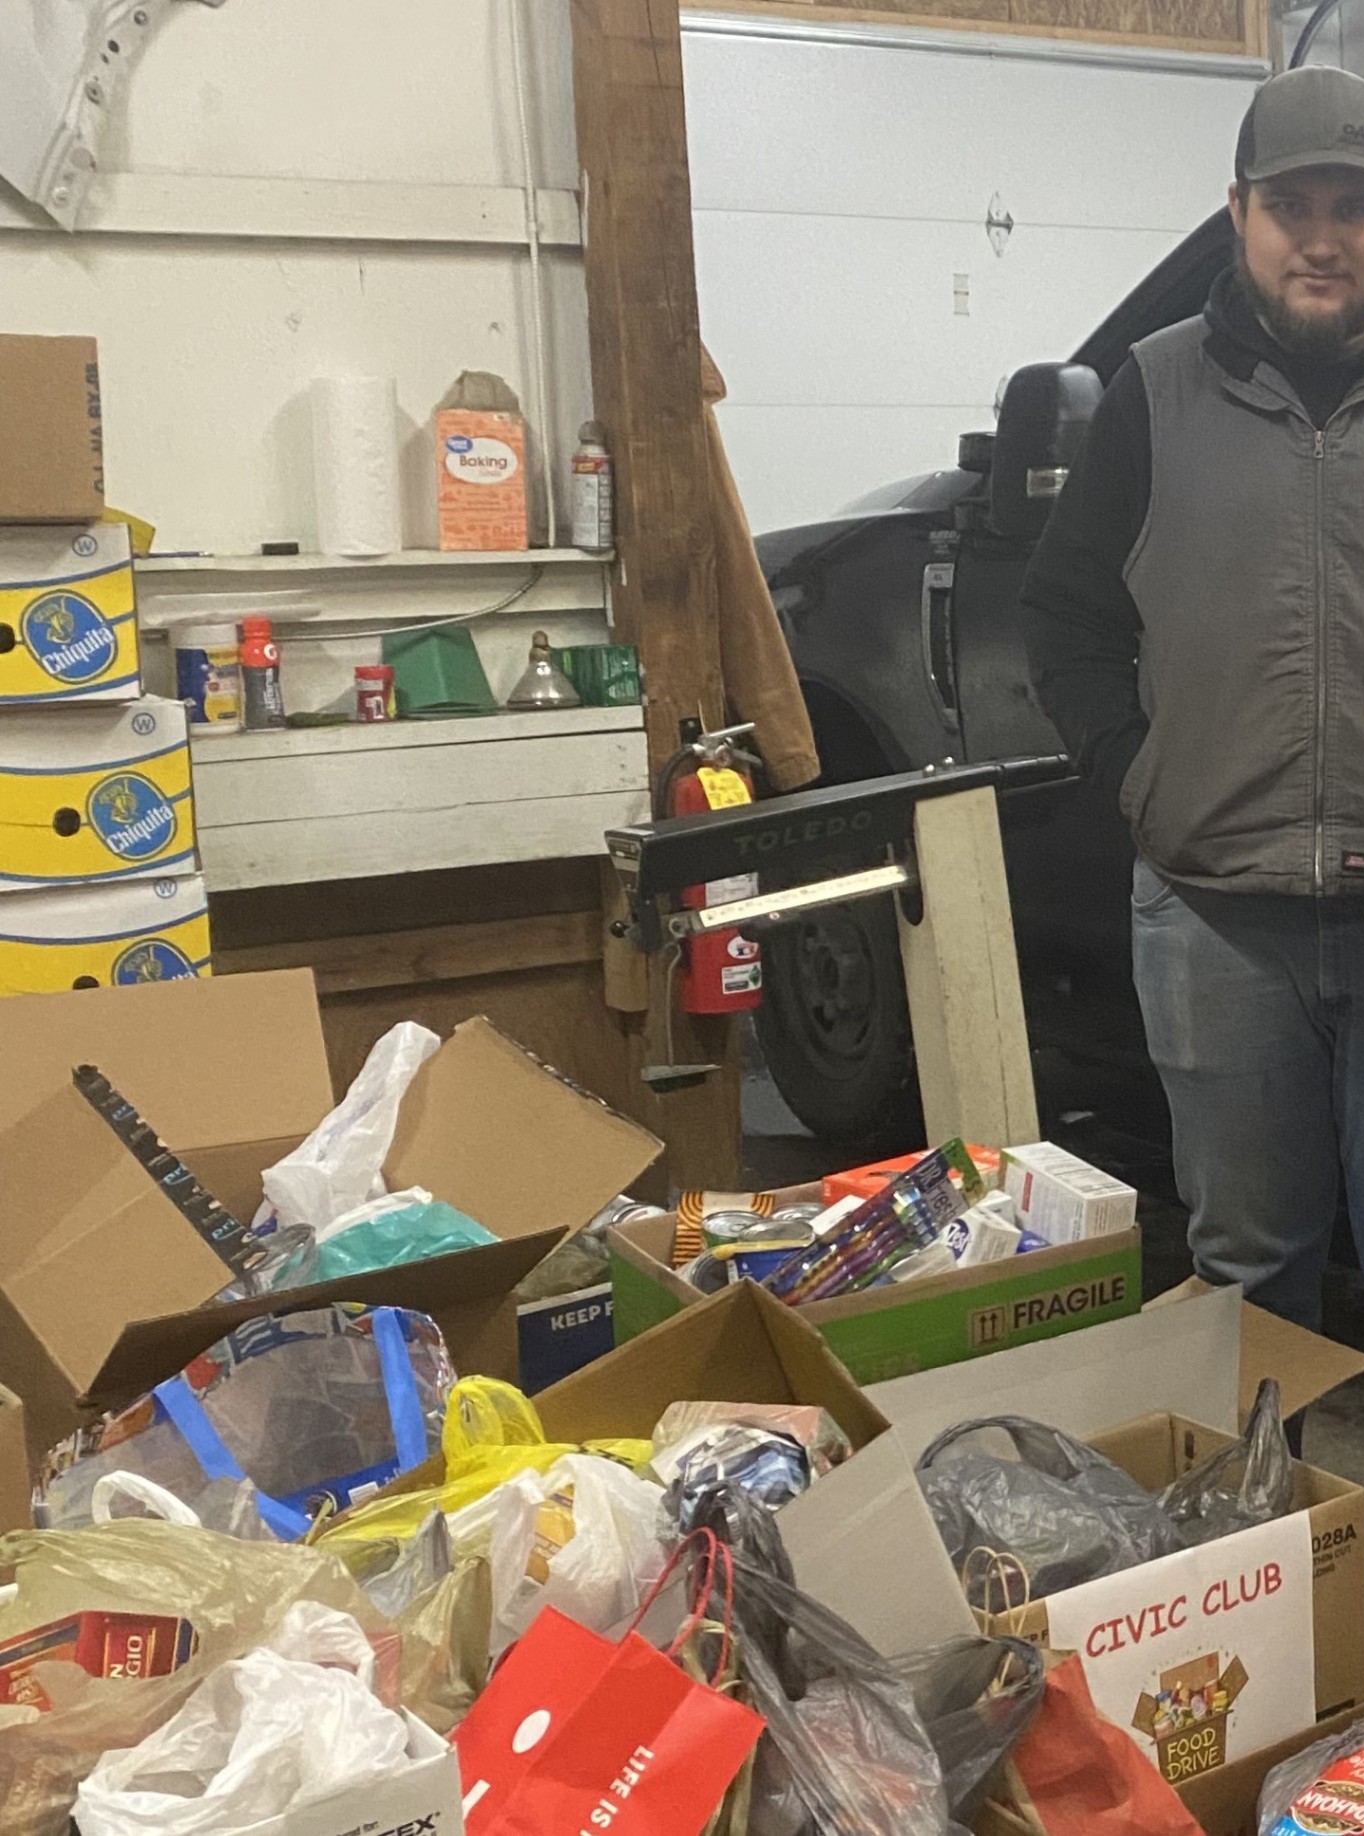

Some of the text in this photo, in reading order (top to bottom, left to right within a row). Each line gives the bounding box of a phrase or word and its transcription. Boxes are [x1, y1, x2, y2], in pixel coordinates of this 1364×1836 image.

[460, 454, 508, 469] Baking
[42, 625, 113, 677] Chiquita
[106, 803, 173, 854] Chiquita
[734, 811, 871, 854] TOLEDO
[551, 1305, 601, 1331] KEEP
[1013, 1277, 1124, 1329] FRAGILE
[1086, 1562, 1282, 1657] CIVIC CLUB
[126, 1634, 143, 1678] GIO
[1167, 1727, 1216, 1762] FOOD
[1167, 1746, 1219, 1780] DRIVE
[590, 1745, 654, 1828] LIFE IS
